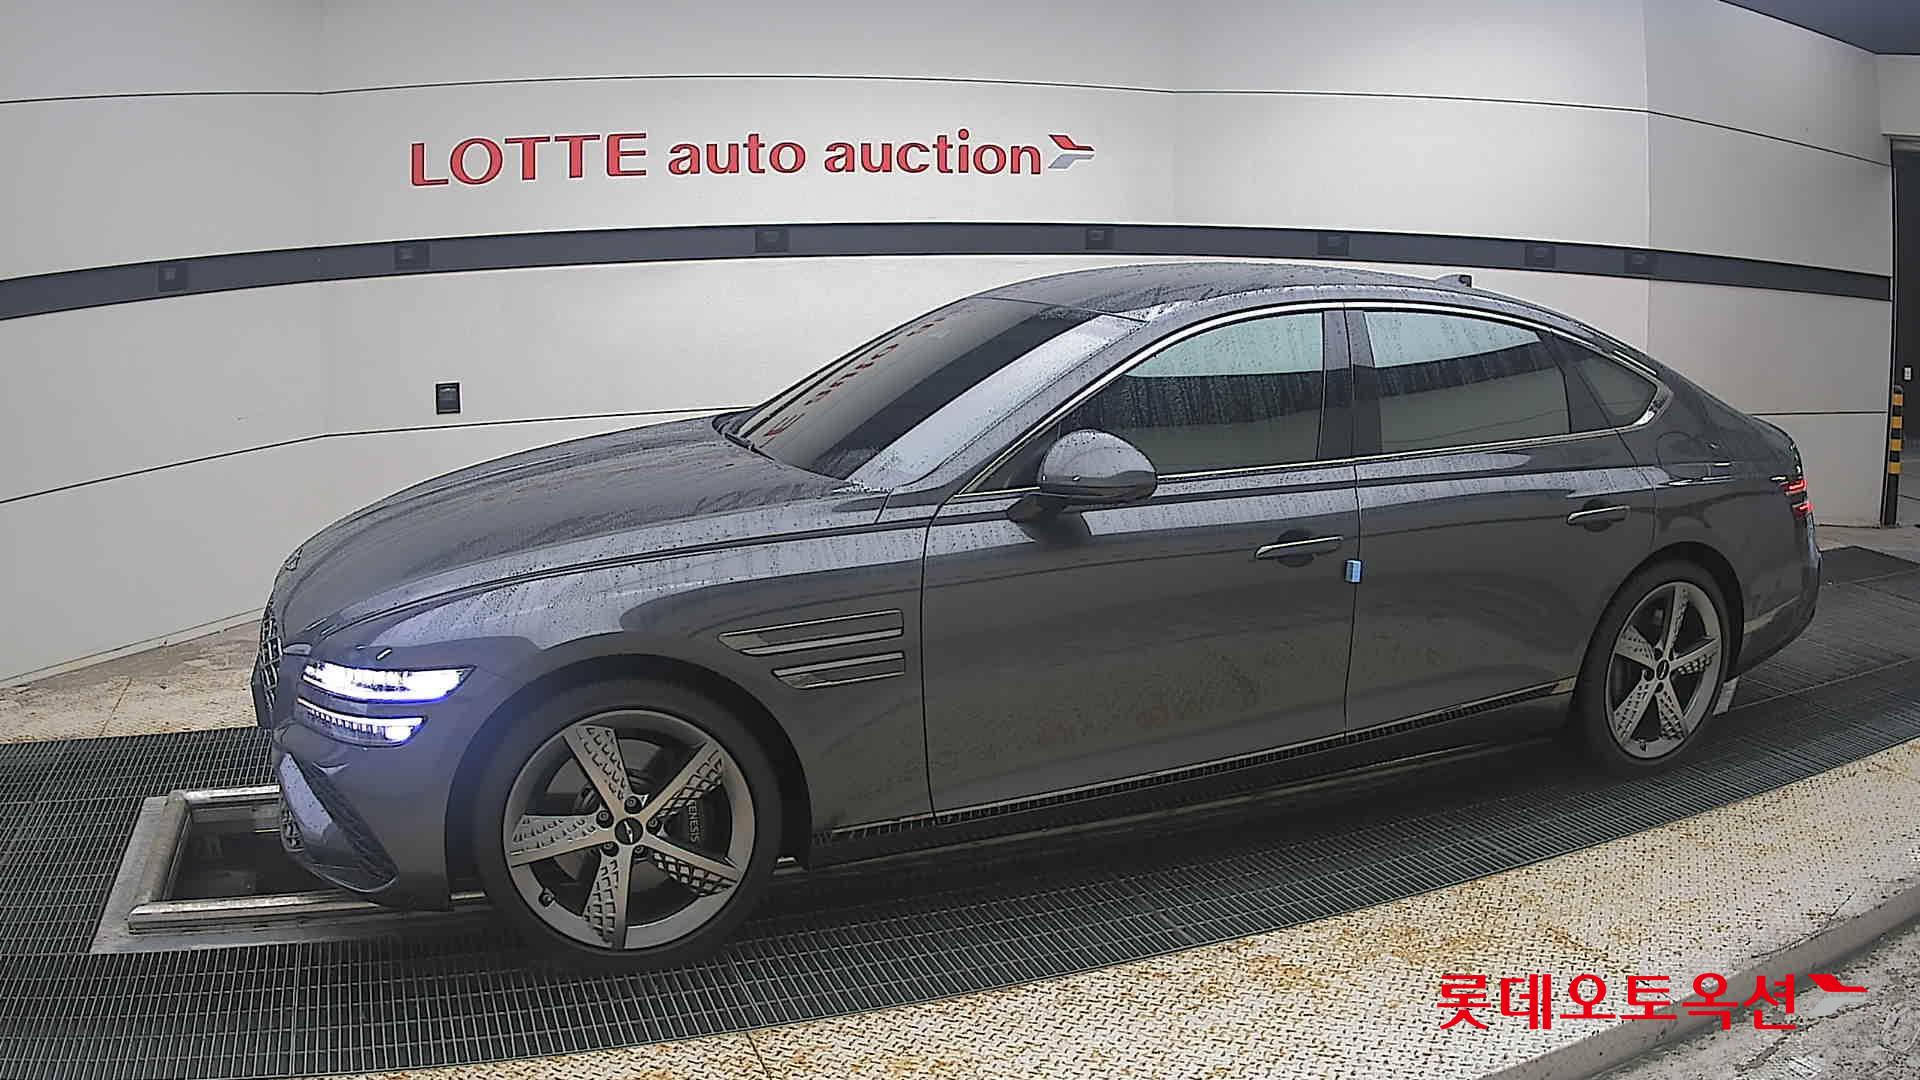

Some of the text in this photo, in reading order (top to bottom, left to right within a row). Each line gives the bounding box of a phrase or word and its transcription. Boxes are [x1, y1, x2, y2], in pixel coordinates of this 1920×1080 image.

[410, 128, 1041, 186] LOTTE auto auction
